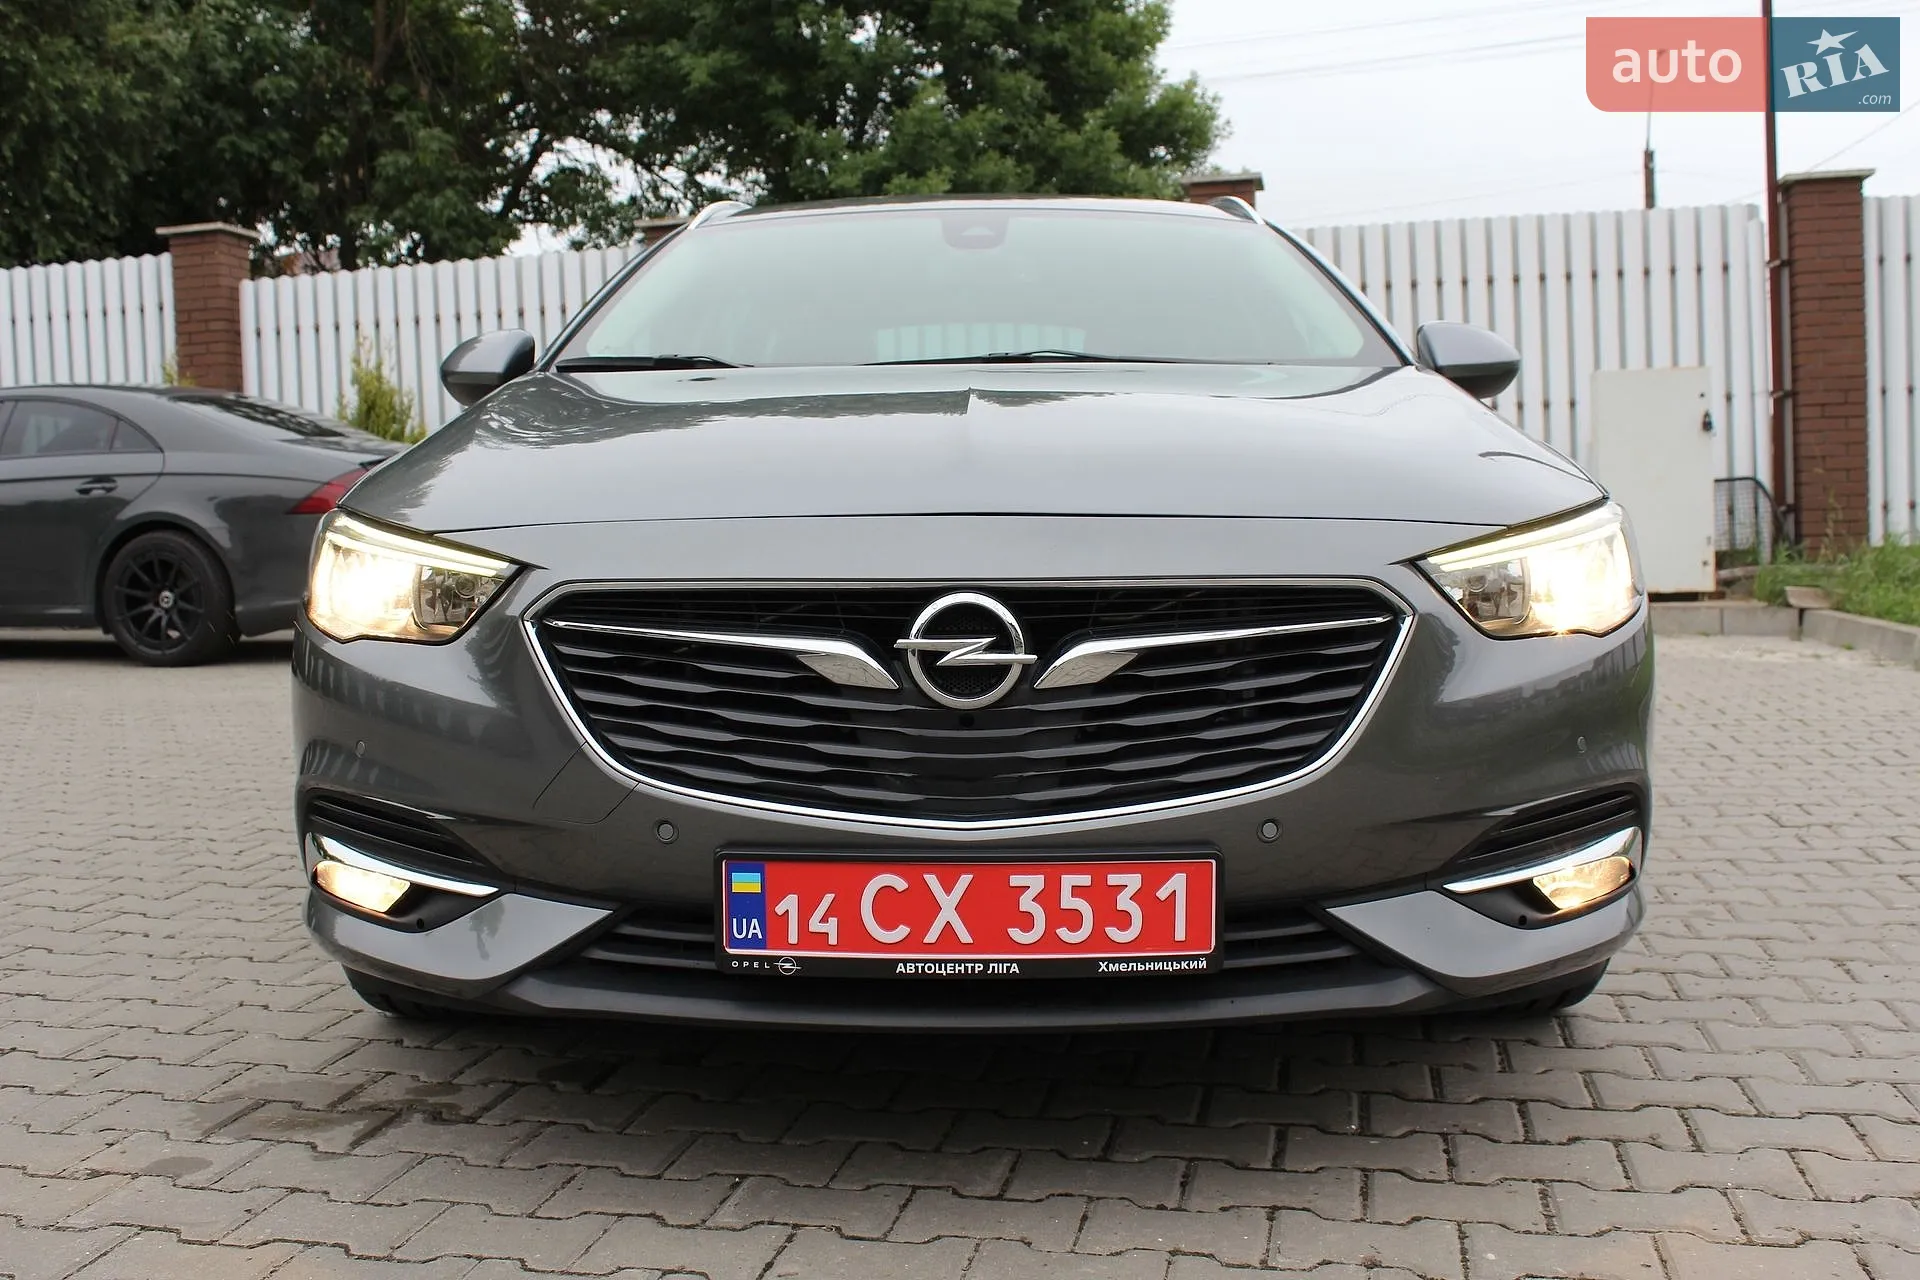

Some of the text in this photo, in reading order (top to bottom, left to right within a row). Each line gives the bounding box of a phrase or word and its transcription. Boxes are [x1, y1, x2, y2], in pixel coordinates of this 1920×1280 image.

[774, 893, 839, 945] 14
[1006, 873, 1187, 944] 3531
[732, 918, 763, 940] UA
[731, 961, 770, 969] OPEL
[895, 962, 1020, 976] АВТОЦЕНТР ЛІГА
[1098, 957, 1207, 974] Хмельницький
